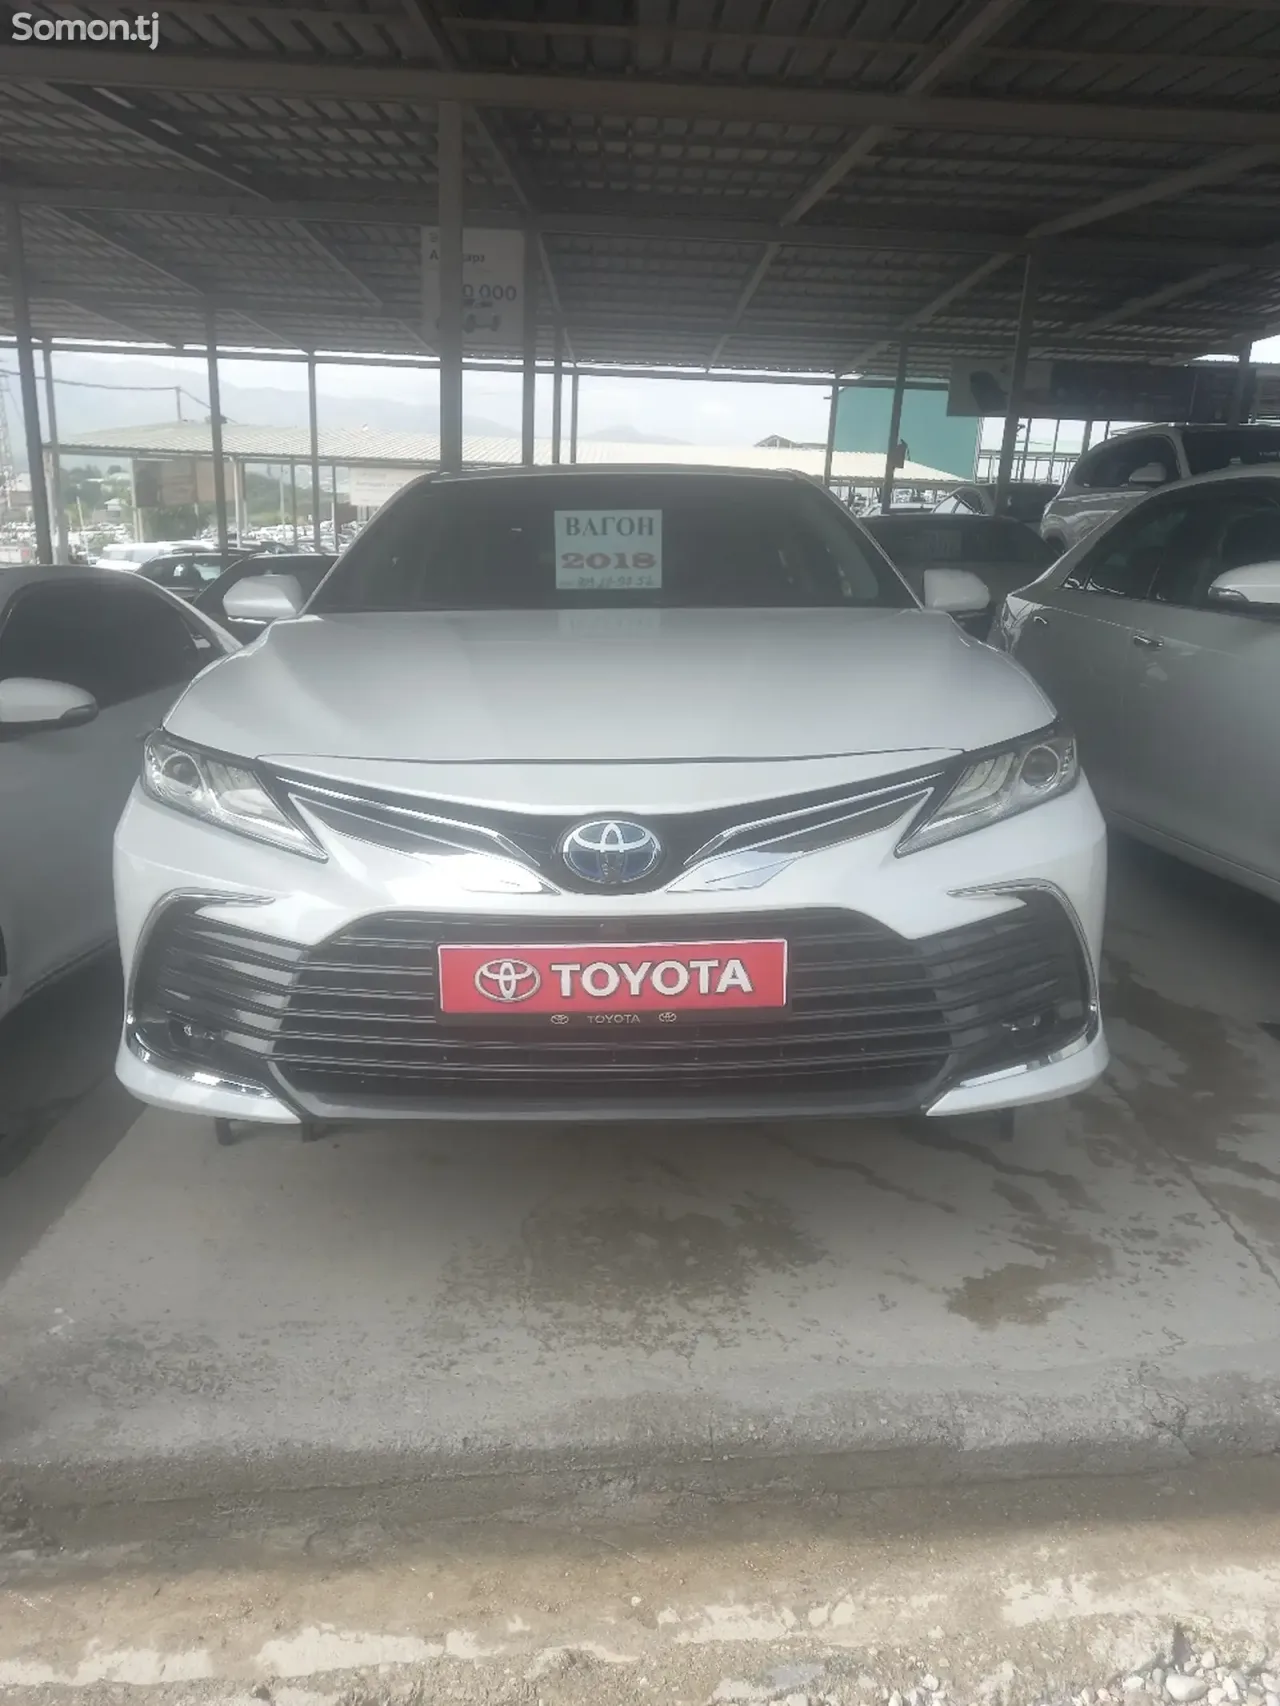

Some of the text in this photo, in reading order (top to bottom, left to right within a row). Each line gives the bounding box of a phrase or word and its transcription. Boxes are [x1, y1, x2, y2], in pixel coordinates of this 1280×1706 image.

[564, 516, 655, 537] ВАГОН
[561, 552, 657, 570] 2018
[551, 959, 754, 998] TOYOTA
[587, 1013, 641, 1024] TOYOTA
